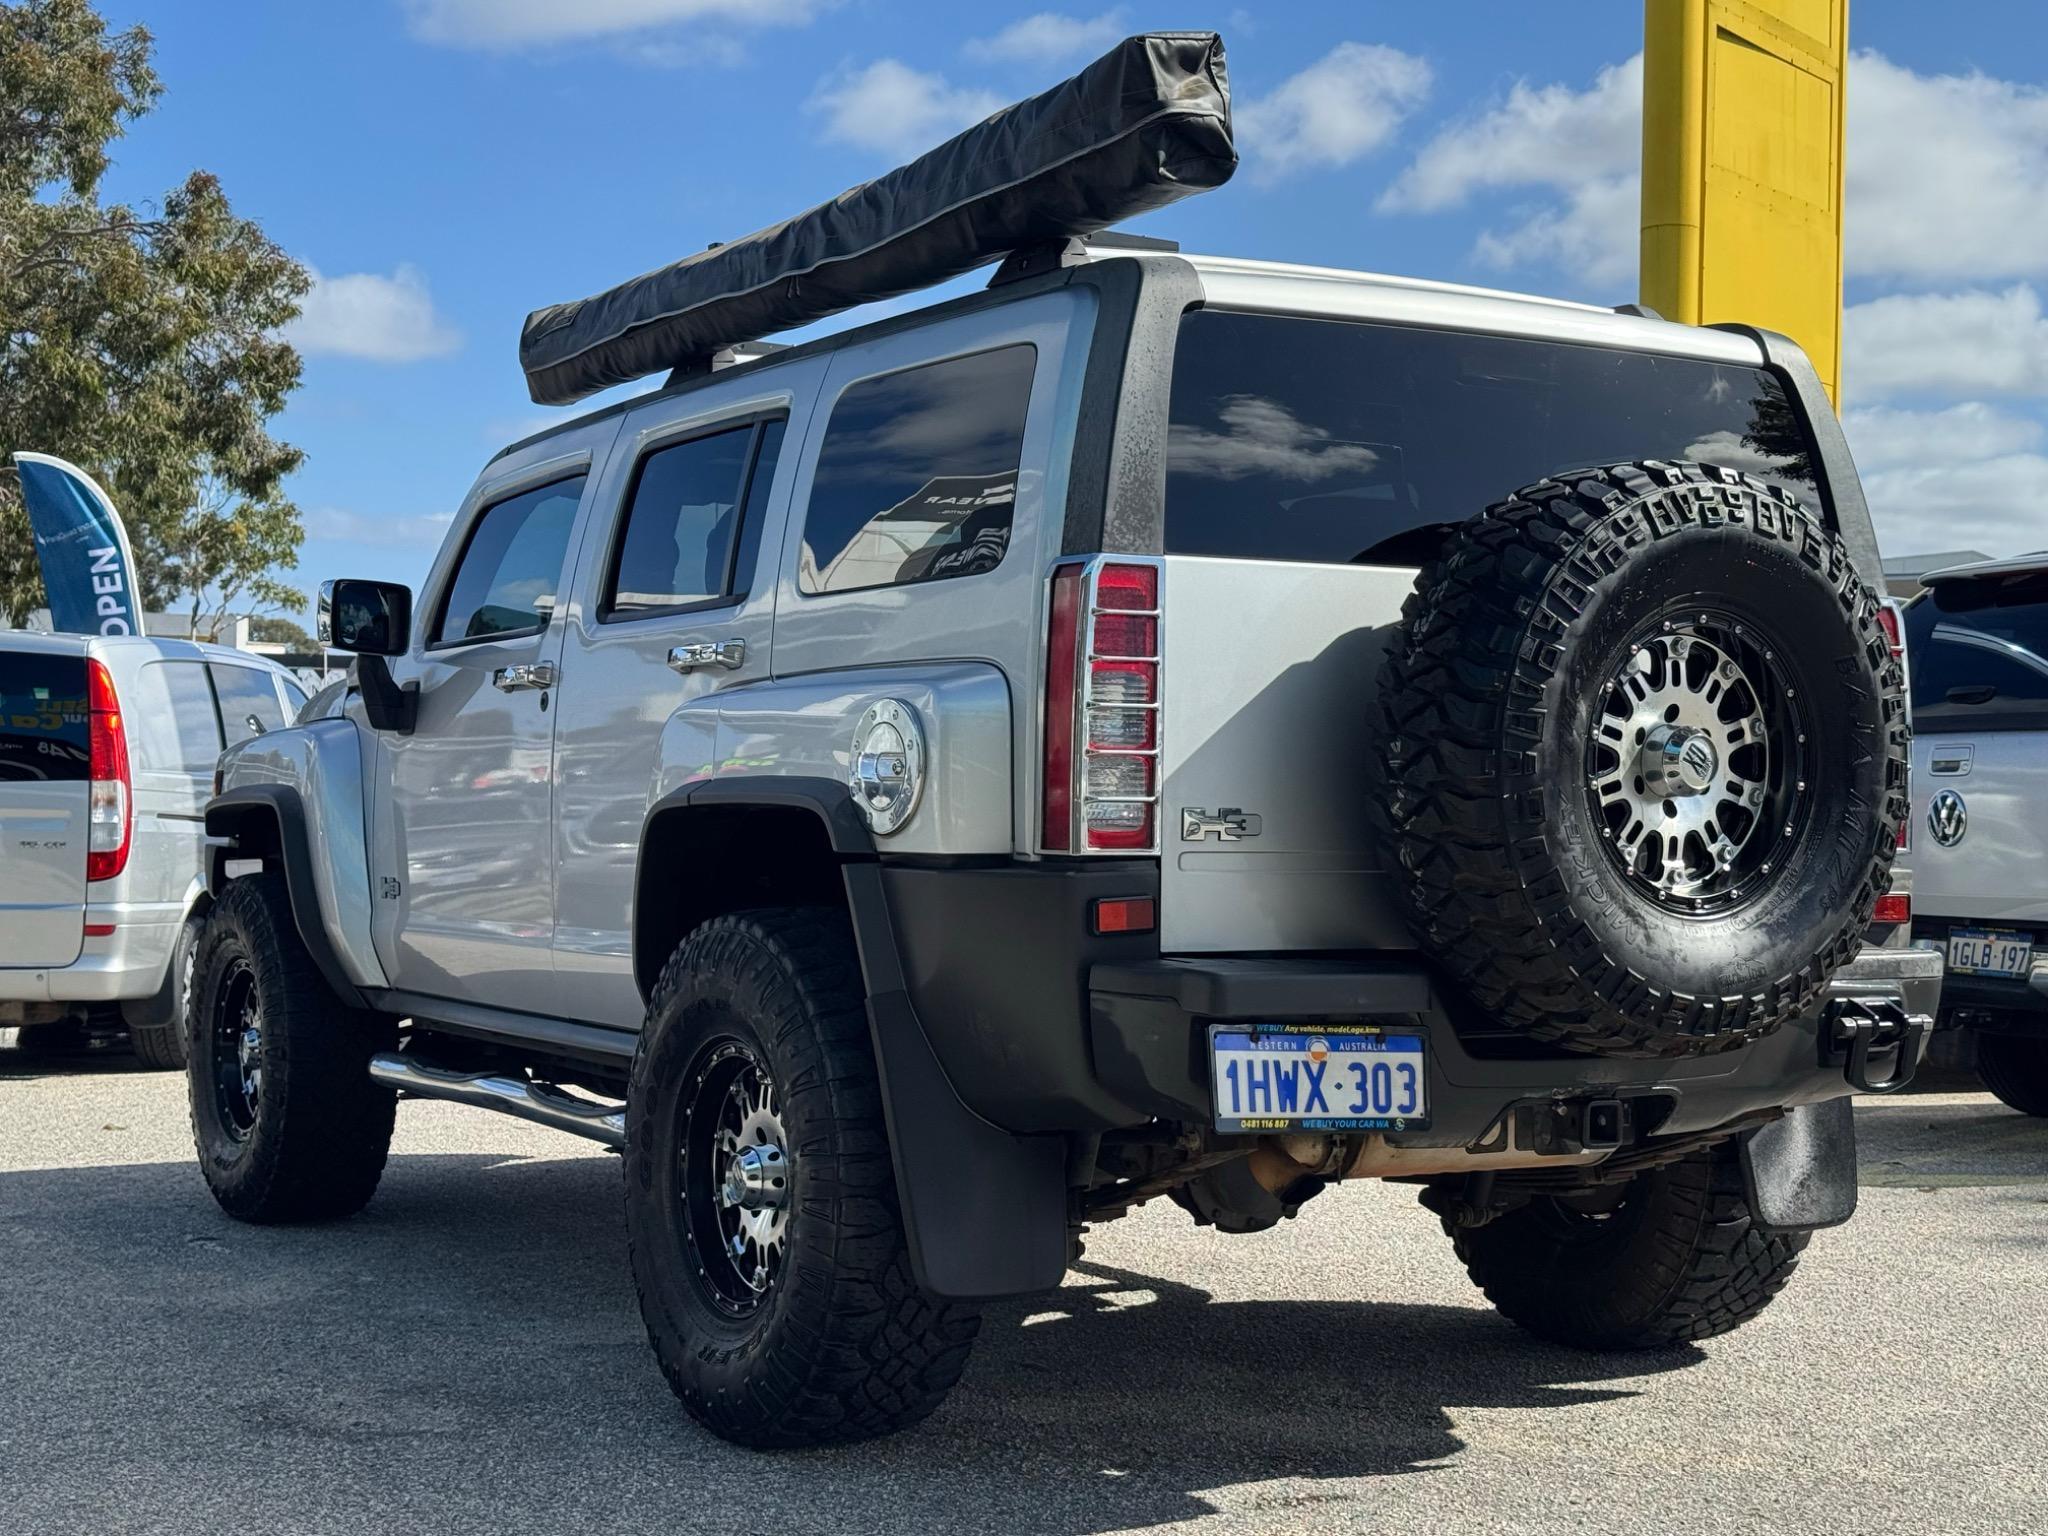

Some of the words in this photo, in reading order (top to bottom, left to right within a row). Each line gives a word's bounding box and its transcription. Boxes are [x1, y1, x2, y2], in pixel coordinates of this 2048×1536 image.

[87, 546, 130, 636] OPEN
[1682, 743, 1707, 778] XD
[1558, 788, 1636, 946] MICKEY
[1953, 942, 1992, 968] 1GLB
[2000, 945, 2028, 971] 197
[1285, 1025, 1299, 1033] Any
[1339, 1042, 1387, 1051] AUSTRALIA
[1226, 1059, 1330, 1113] 1HWX
[1347, 1062, 1417, 1114] 303
[1240, 1120, 1260, 1128] 0481
[1261, 1120, 1273, 1128] 116
[1274, 1120, 1290, 1128] 887
[1302, 1120, 1315, 1129] WE
[1316, 1120, 1333, 1129] BUY
[1334, 1120, 1357, 1129] YOUR
[1358, 1120, 1375, 1129] CAR
[1376, 1120, 1390, 1129] WA
